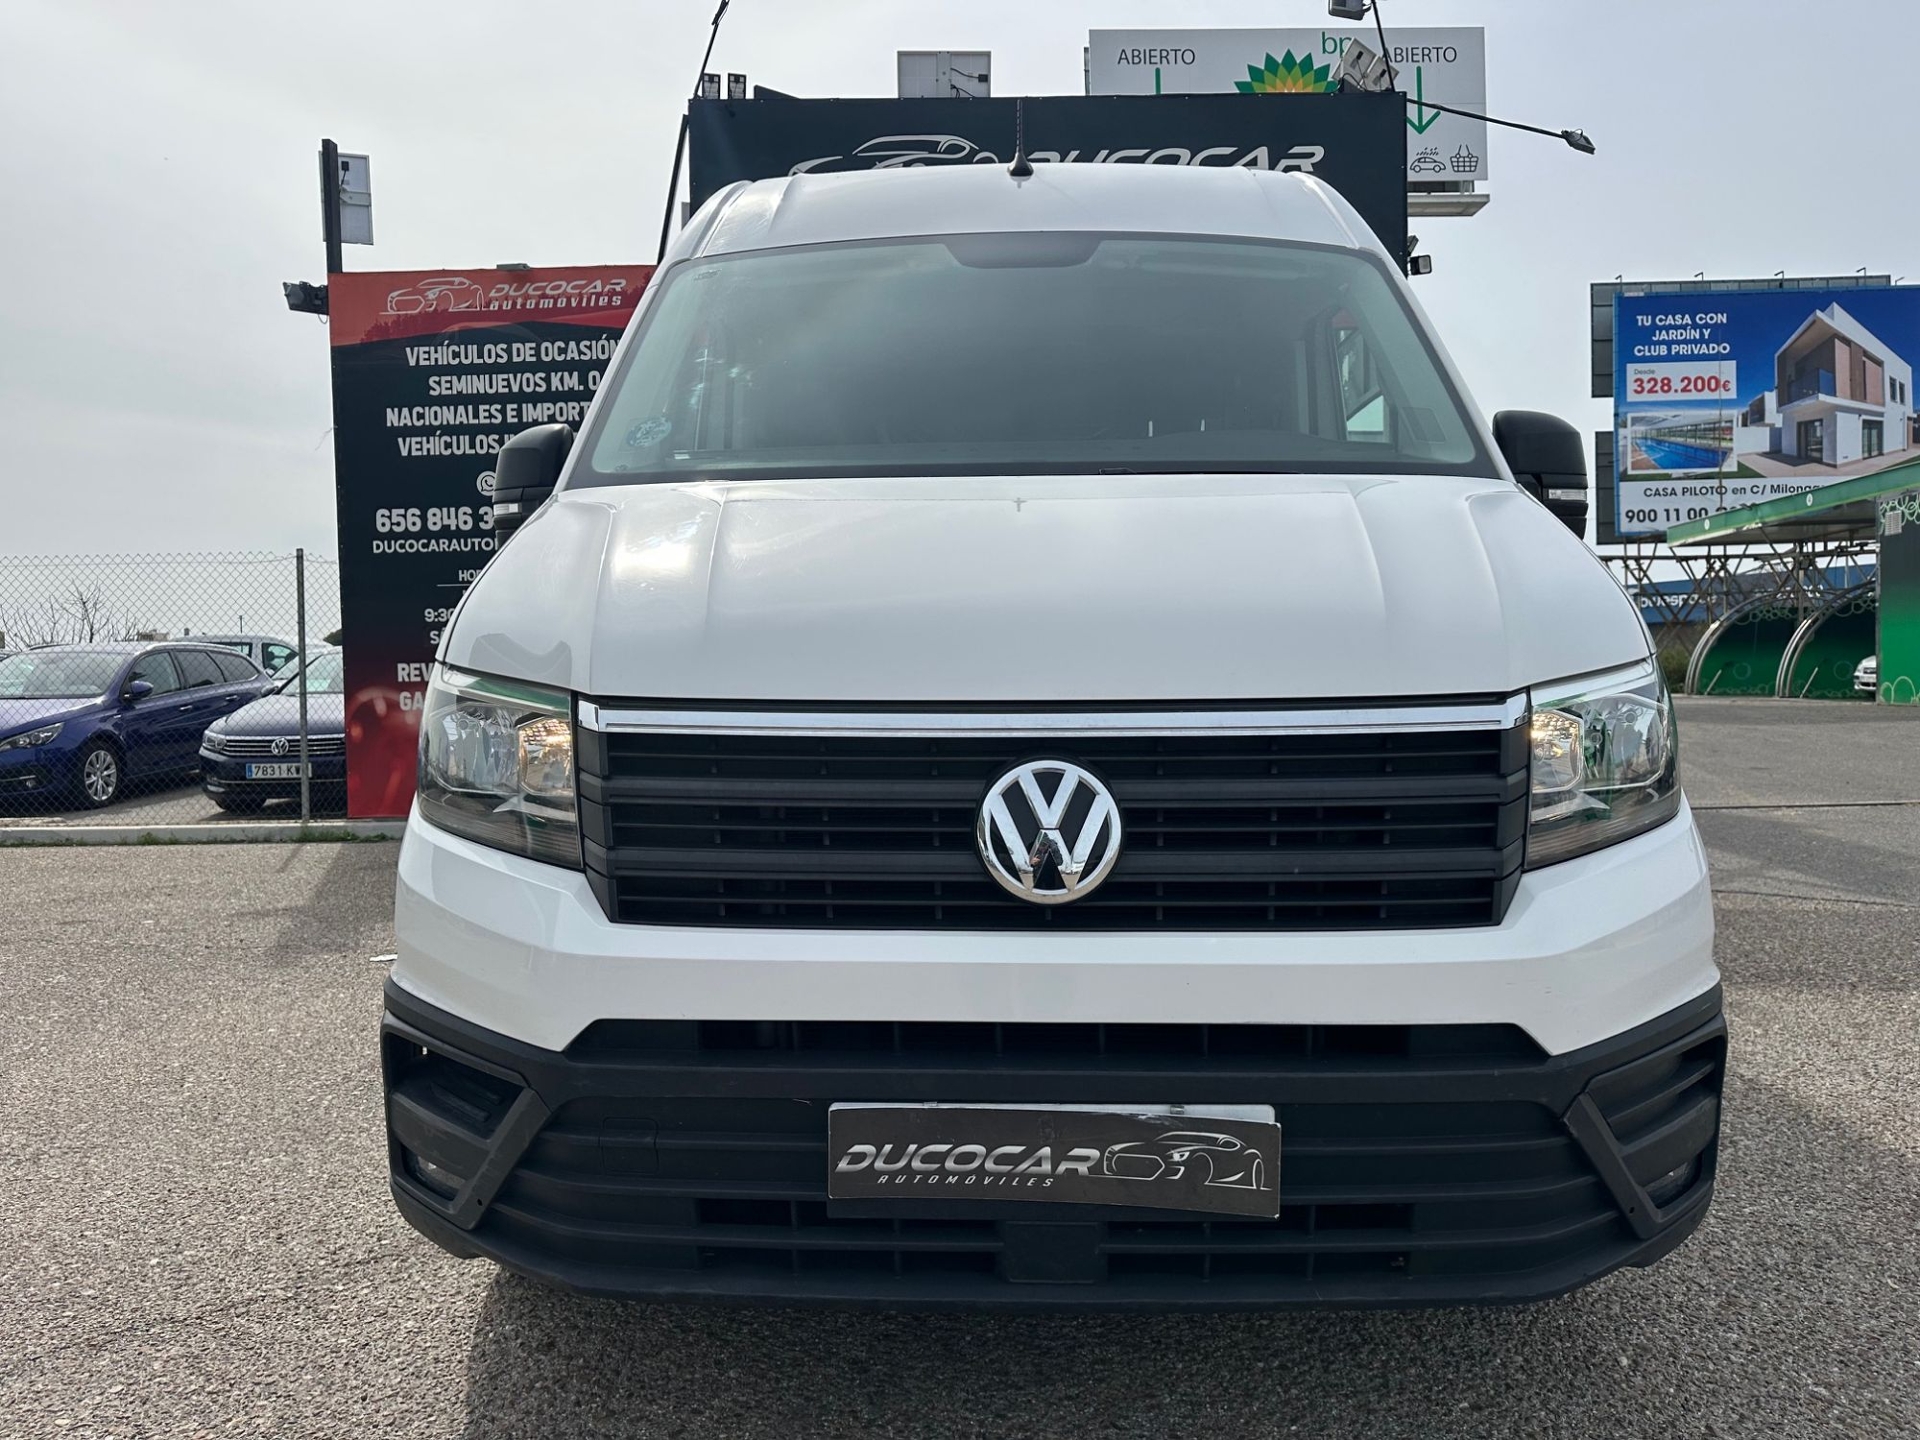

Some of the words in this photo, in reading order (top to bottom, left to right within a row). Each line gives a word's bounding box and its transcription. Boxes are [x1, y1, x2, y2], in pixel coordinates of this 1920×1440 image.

[1117, 48, 1196, 66] ABIERTO
[489, 278, 627, 297] DUCOCAR
[489, 294, 622, 311] automóviles
[1636, 315, 1651, 326] TU
[1655, 314, 1692, 326] CASA
[1696, 313, 1727, 324] CON
[1652, 326, 1700, 341] JARDÍN
[1703, 328, 1711, 339] Y
[405, 340, 508, 366] VEHÍCULOS
[512, 344, 538, 362] DE
[1634, 344, 1668, 356] CLUB
[1671, 343, 1731, 355] PRIVADO
[428, 373, 546, 396] SEMINUEVOS
[550, 371, 584, 392] KM.
[1633, 375, 1731, 395] 328.200€
[386, 403, 502, 427] NACIONALES
[506, 404, 518, 424] E
[397, 430, 501, 456] VEHÍCULOS
[1643, 487, 1677, 498] CASA
[1682, 485, 1728, 496] PILOTO
[1732, 486, 1747, 495] en
[1750, 484, 1766, 495] C/
[375, 507, 422, 533] 656
[427, 506, 473, 531] 846
[1625, 508, 1657, 523] 900
[1661, 508, 1681, 522] 11
[1687, 507, 1709, 521] 00
[254, 765, 282, 776] 7831
[835, 1144, 1101, 1176] DUCOCAR
[877, 1173, 1056, 1188] AUTOMÓVILES
